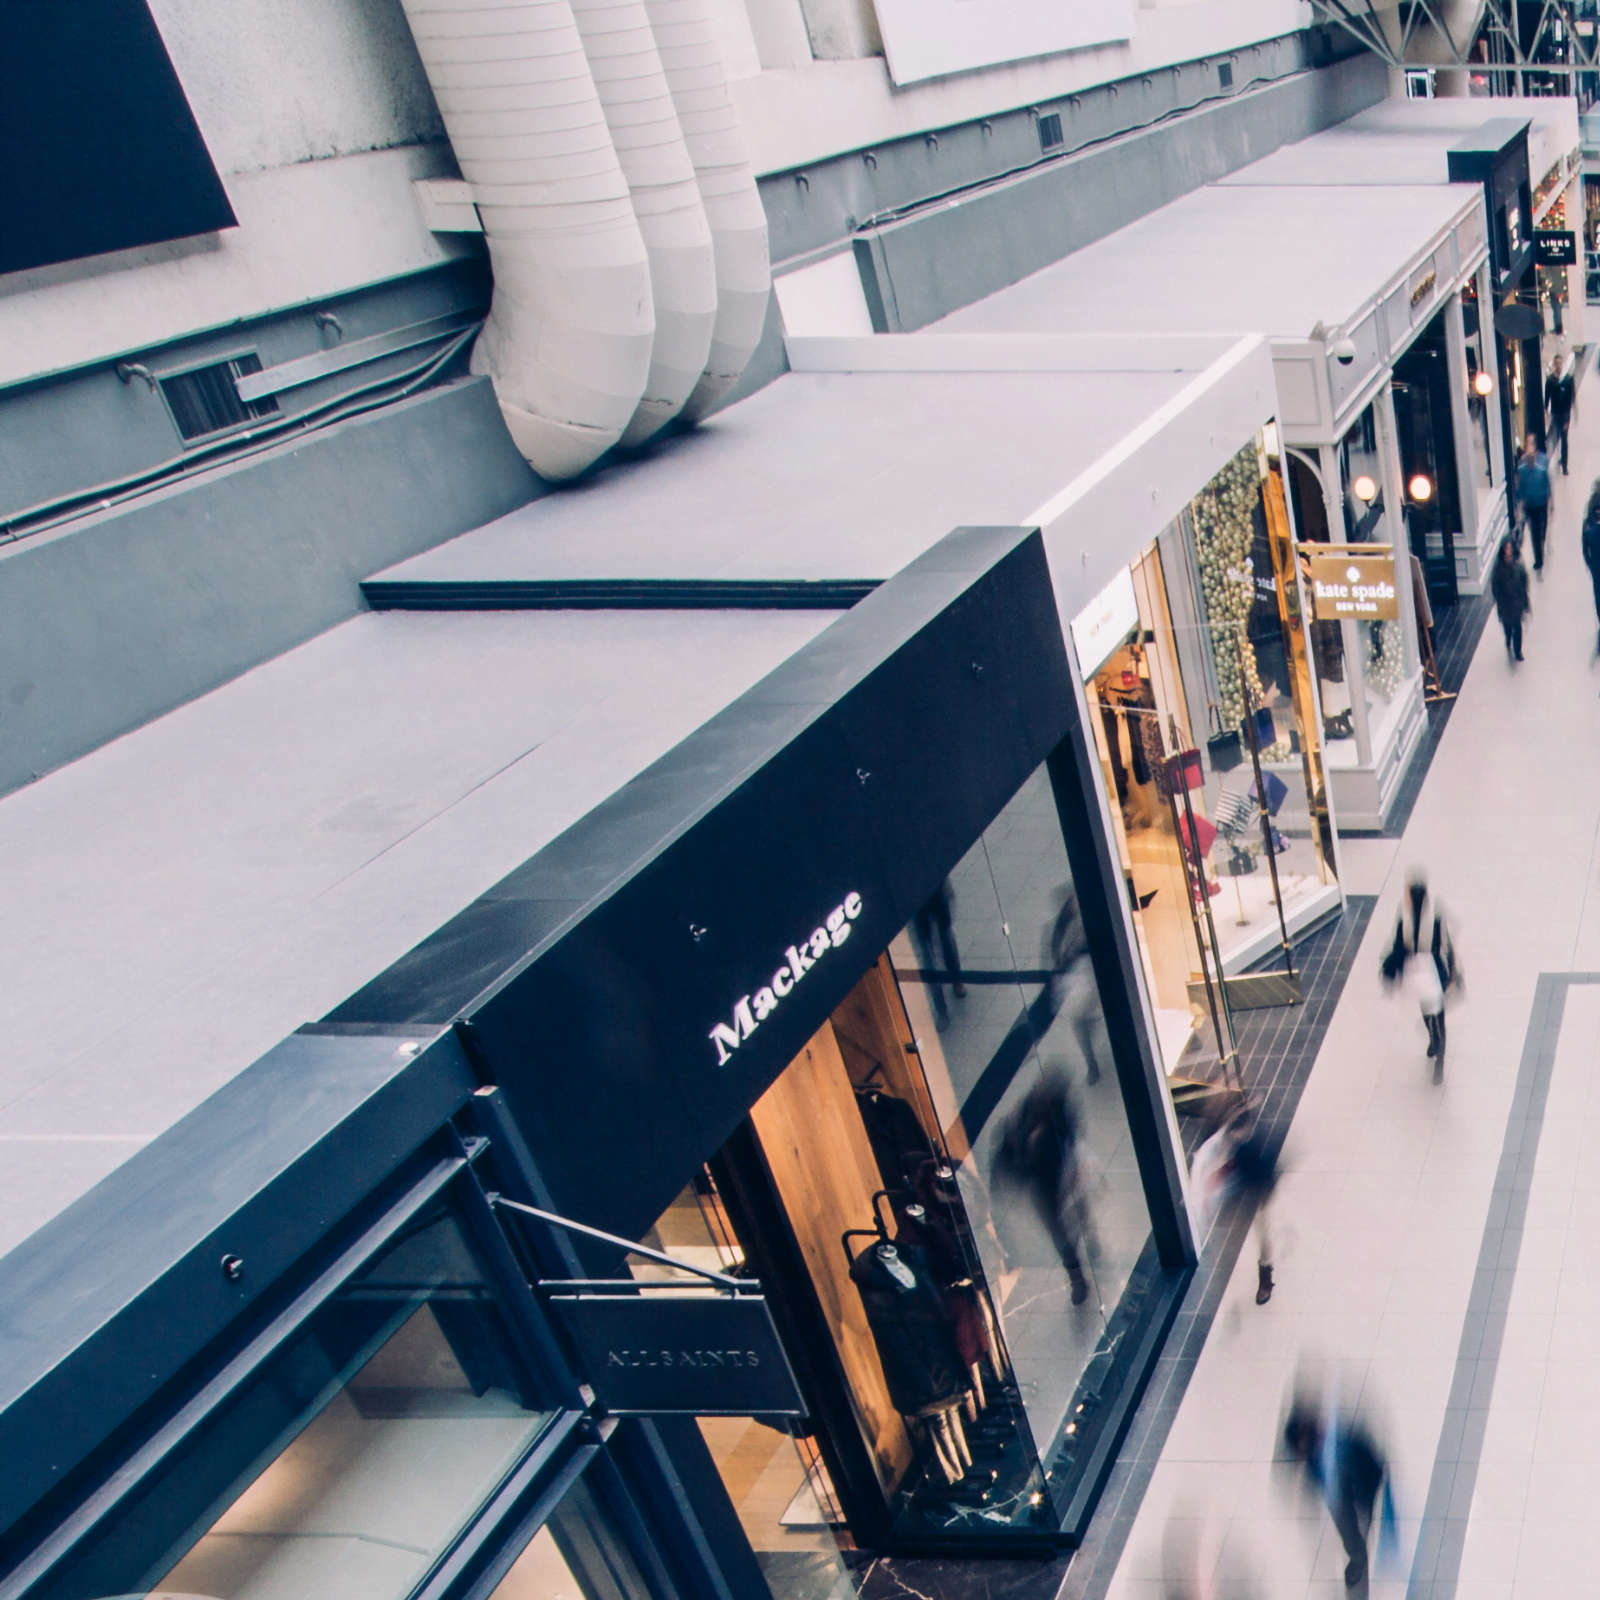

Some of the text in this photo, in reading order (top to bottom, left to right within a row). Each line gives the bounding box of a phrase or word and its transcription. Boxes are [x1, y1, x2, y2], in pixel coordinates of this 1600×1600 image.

[1540, 239, 1570, 247] LINKS
[1315, 580, 1395, 602] kate spade
[1335, 602, 1378, 611] NEW YORK
[709, 891, 862, 1067] Mackage
[607, 1351, 760, 1367] ALLSAINTS
